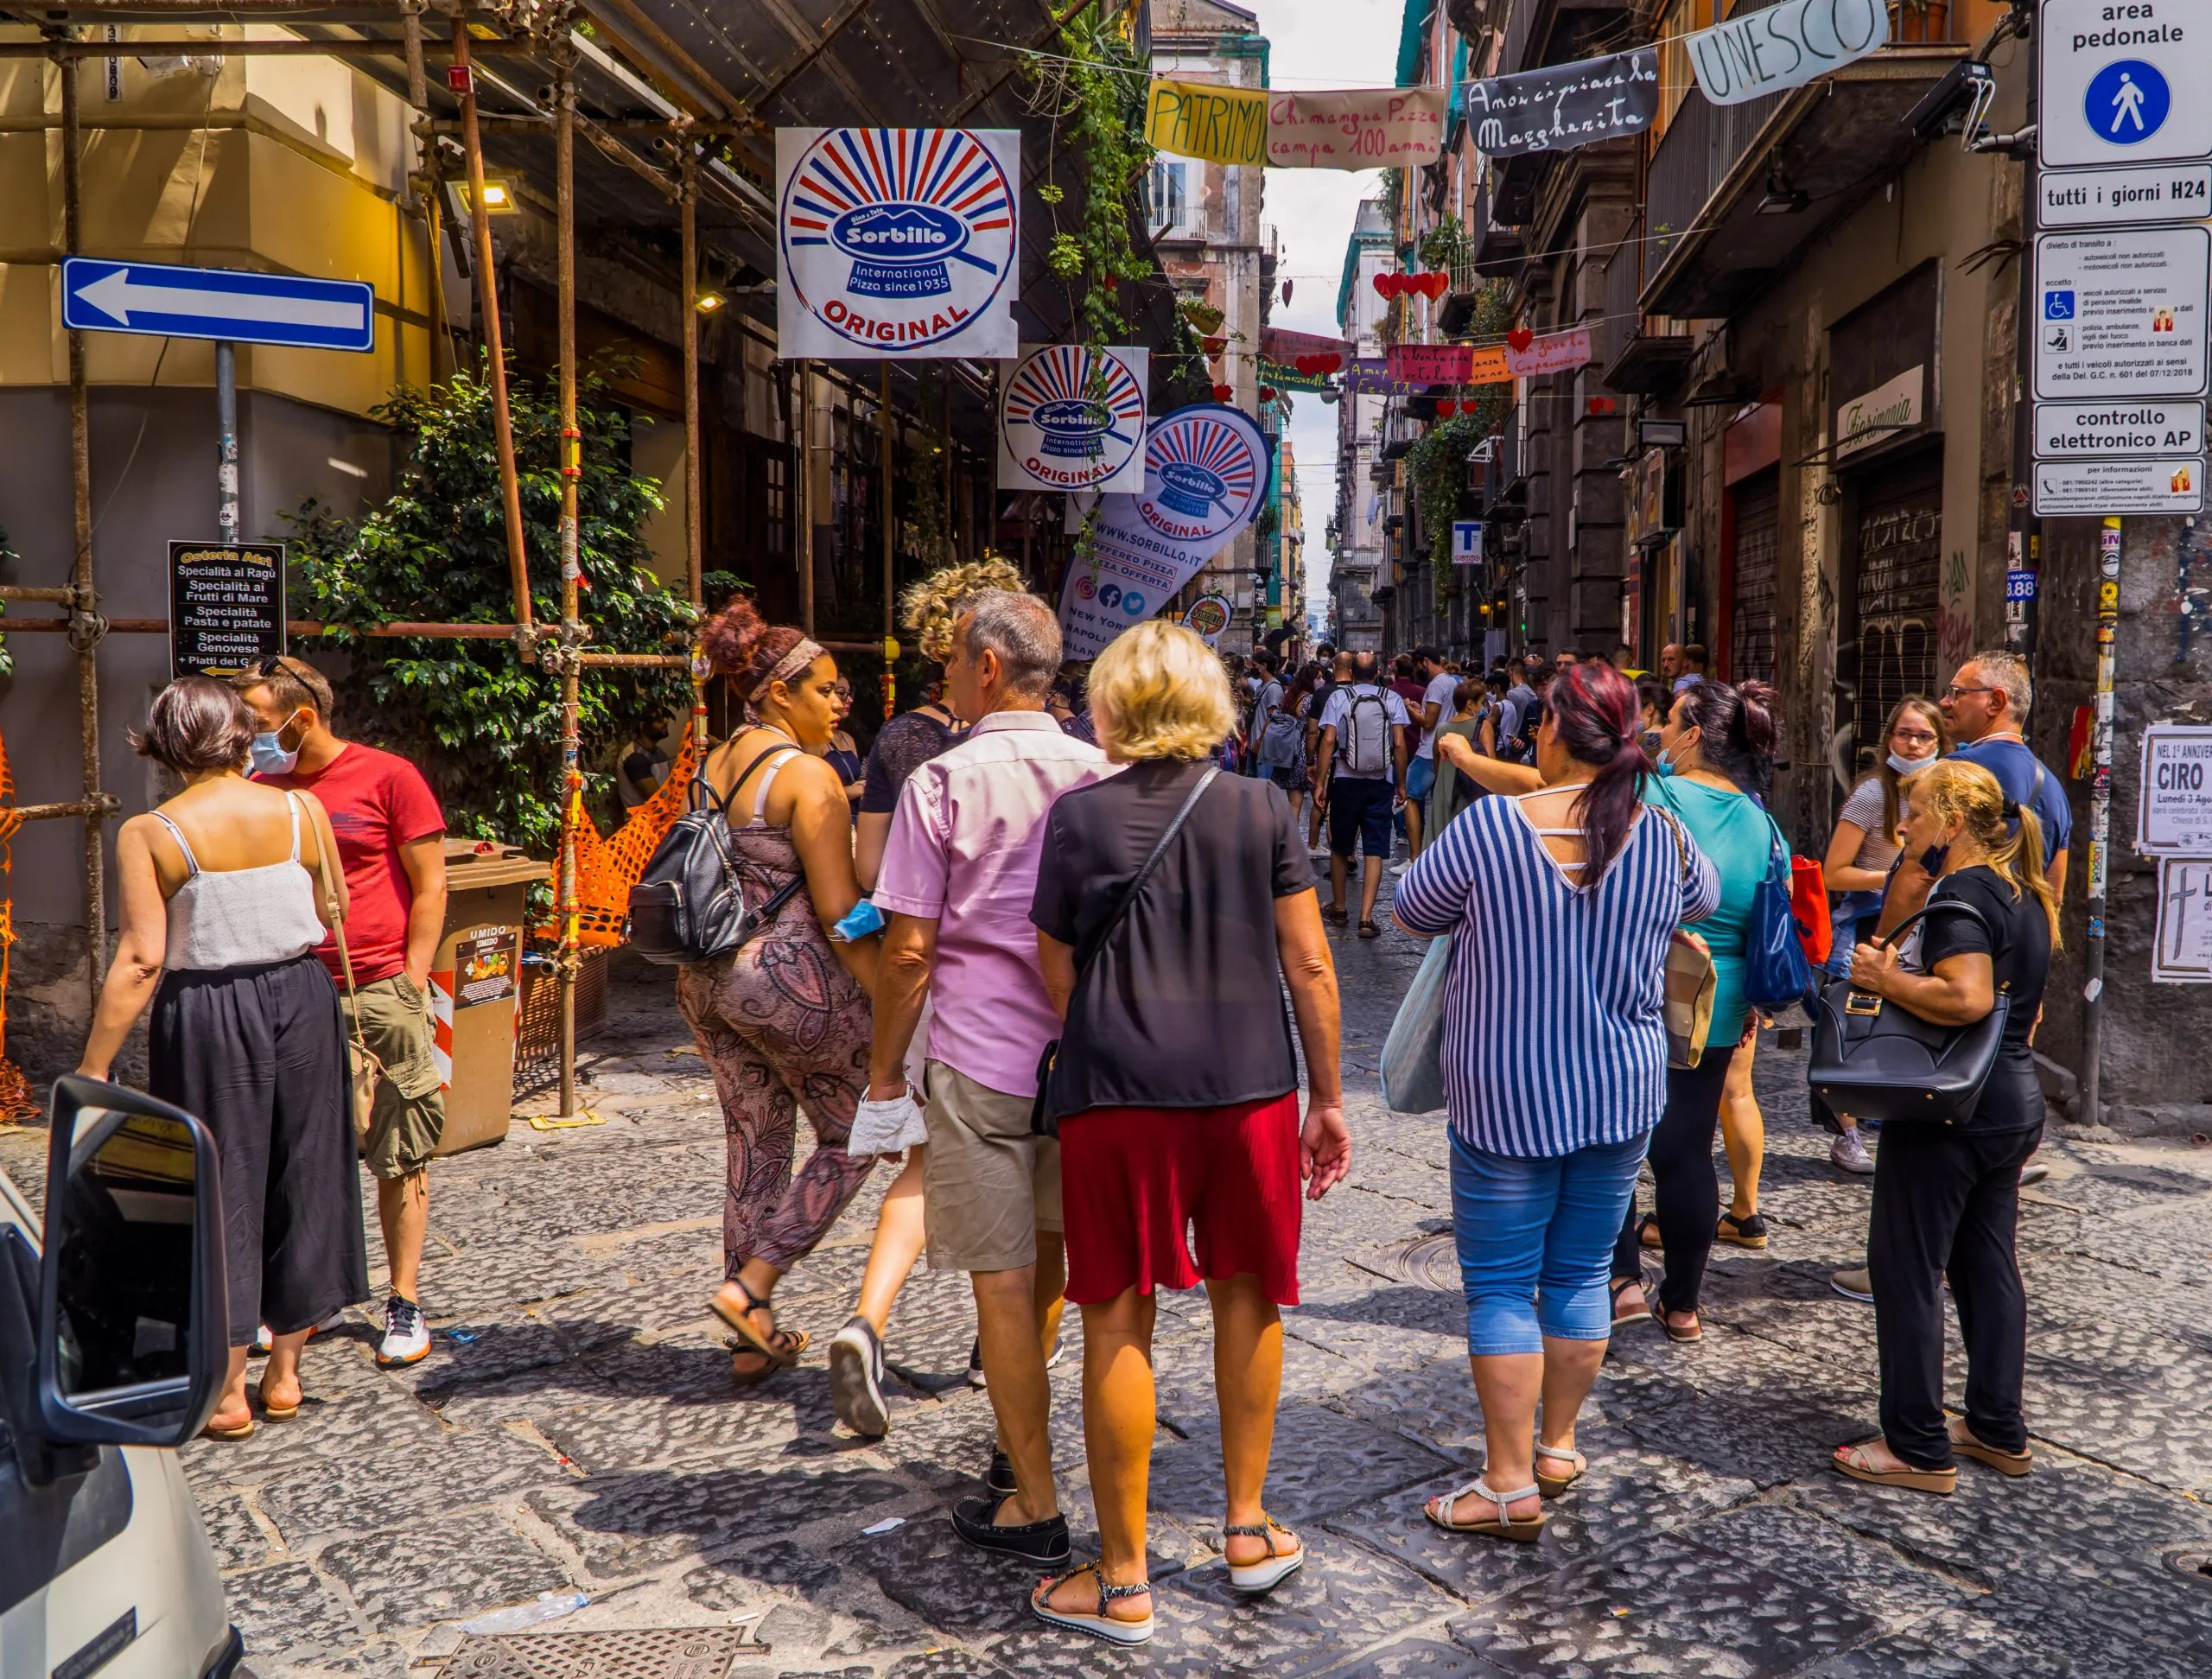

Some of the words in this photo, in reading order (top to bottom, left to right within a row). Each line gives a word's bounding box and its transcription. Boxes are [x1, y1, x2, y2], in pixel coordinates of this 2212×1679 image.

[2102, 3, 2153, 21] area
[2073, 24, 2183, 52] pedonale
[1698, 0, 1875, 98] UNESCO
[1270, 96, 1305, 126] Chi
[1310, 111, 1382, 136] mangia
[1478, 97, 1644, 151] Margherita
[1271, 141, 1336, 168] campa
[1348, 128, 1386, 157] 100
[1389, 137, 1438, 155] anni
[2047, 187, 2087, 207] tutti
[2097, 186, 2102, 204] i
[2112, 182, 2160, 207] giorni
[2171, 179, 2206, 200] H24
[847, 226, 947, 244] Sorbillo
[2046, 241, 2069, 250] divieto
[2079, 240, 2106, 249] transito
[2083, 253, 2117, 262] autoveicoli
[856, 264, 943, 279] International
[849, 277, 880, 291] Pizza
[885, 282, 916, 292] since
[918, 277, 949, 291] 1935
[2104, 288, 2136, 296] autorizzati
[2144, 287, 2167, 296] servizio
[2091, 299, 2117, 308] persone
[2082, 308, 2104, 317] previo
[824, 300, 969, 341] ORIGINAL
[2082, 334, 2097, 342] vigili
[2082, 342, 2104, 351] previo
[2087, 360, 2112, 369] veicoli
[2114, 359, 2154, 367] autorizzati
[2165, 358, 2187, 366] sensi
[2052, 372, 2071, 381] della
[2090, 372, 2108, 380] G.C.
[2120, 370, 2133, 378] 601
[2136, 370, 2148, 378] del
[2076, 409, 2165, 426] controllo
[2050, 432, 2156, 448] elettronico
[2163, 431, 2191, 447] AP
[1042, 443, 1061, 453] Pizza
[1026, 456, 1116, 484] ORIGINAL
[2102, 465, 2152, 474] informazioni
[1166, 470, 1216, 493] Sorbillo
[1141, 502, 1212, 537] ORIGINAL
[1455, 524, 1482, 550] T
[1096, 523, 1203, 567] WWW.SORBILLO.IT
[181, 550, 239, 563] Osteria
[242, 551, 273, 568] Atri
[1090, 541, 1140, 563] OFFERED
[1143, 559, 1173, 576] PIZZA
[178, 565, 232, 577] Specialità
[234, 567, 244, 577] al
[247, 568, 276, 581] Ragù
[1121, 566, 1168, 589] OFFERTA
[189, 580, 251, 592] Specialità
[253, 582, 264, 592] ai
[186, 591, 219, 601] Frutti
[222, 593, 234, 602] di
[238, 594, 268, 603] Mare
[196, 606, 257, 617] Specialità
[1069, 606, 1096, 622] NEW
[1100, 616, 1128, 631] YOR
[1193, 609, 1224, 626] SORBILLO
[184, 616, 219, 627] Pasta
[233, 620, 271, 629] patate
[198, 632, 259, 644] Specialità
[1065, 622, 1107, 644] NAPOLI
[198, 642, 259, 653] Genovese
[188, 656, 217, 665] Piatti
[219, 658, 237, 666] del
[2157, 745, 2171, 759] NEL
[2158, 762, 2203, 791] CIRO
[2187, 794, 2193, 804] 3
[470, 925, 506, 939] UMIDO
[477, 937, 499, 948] UMIDO
